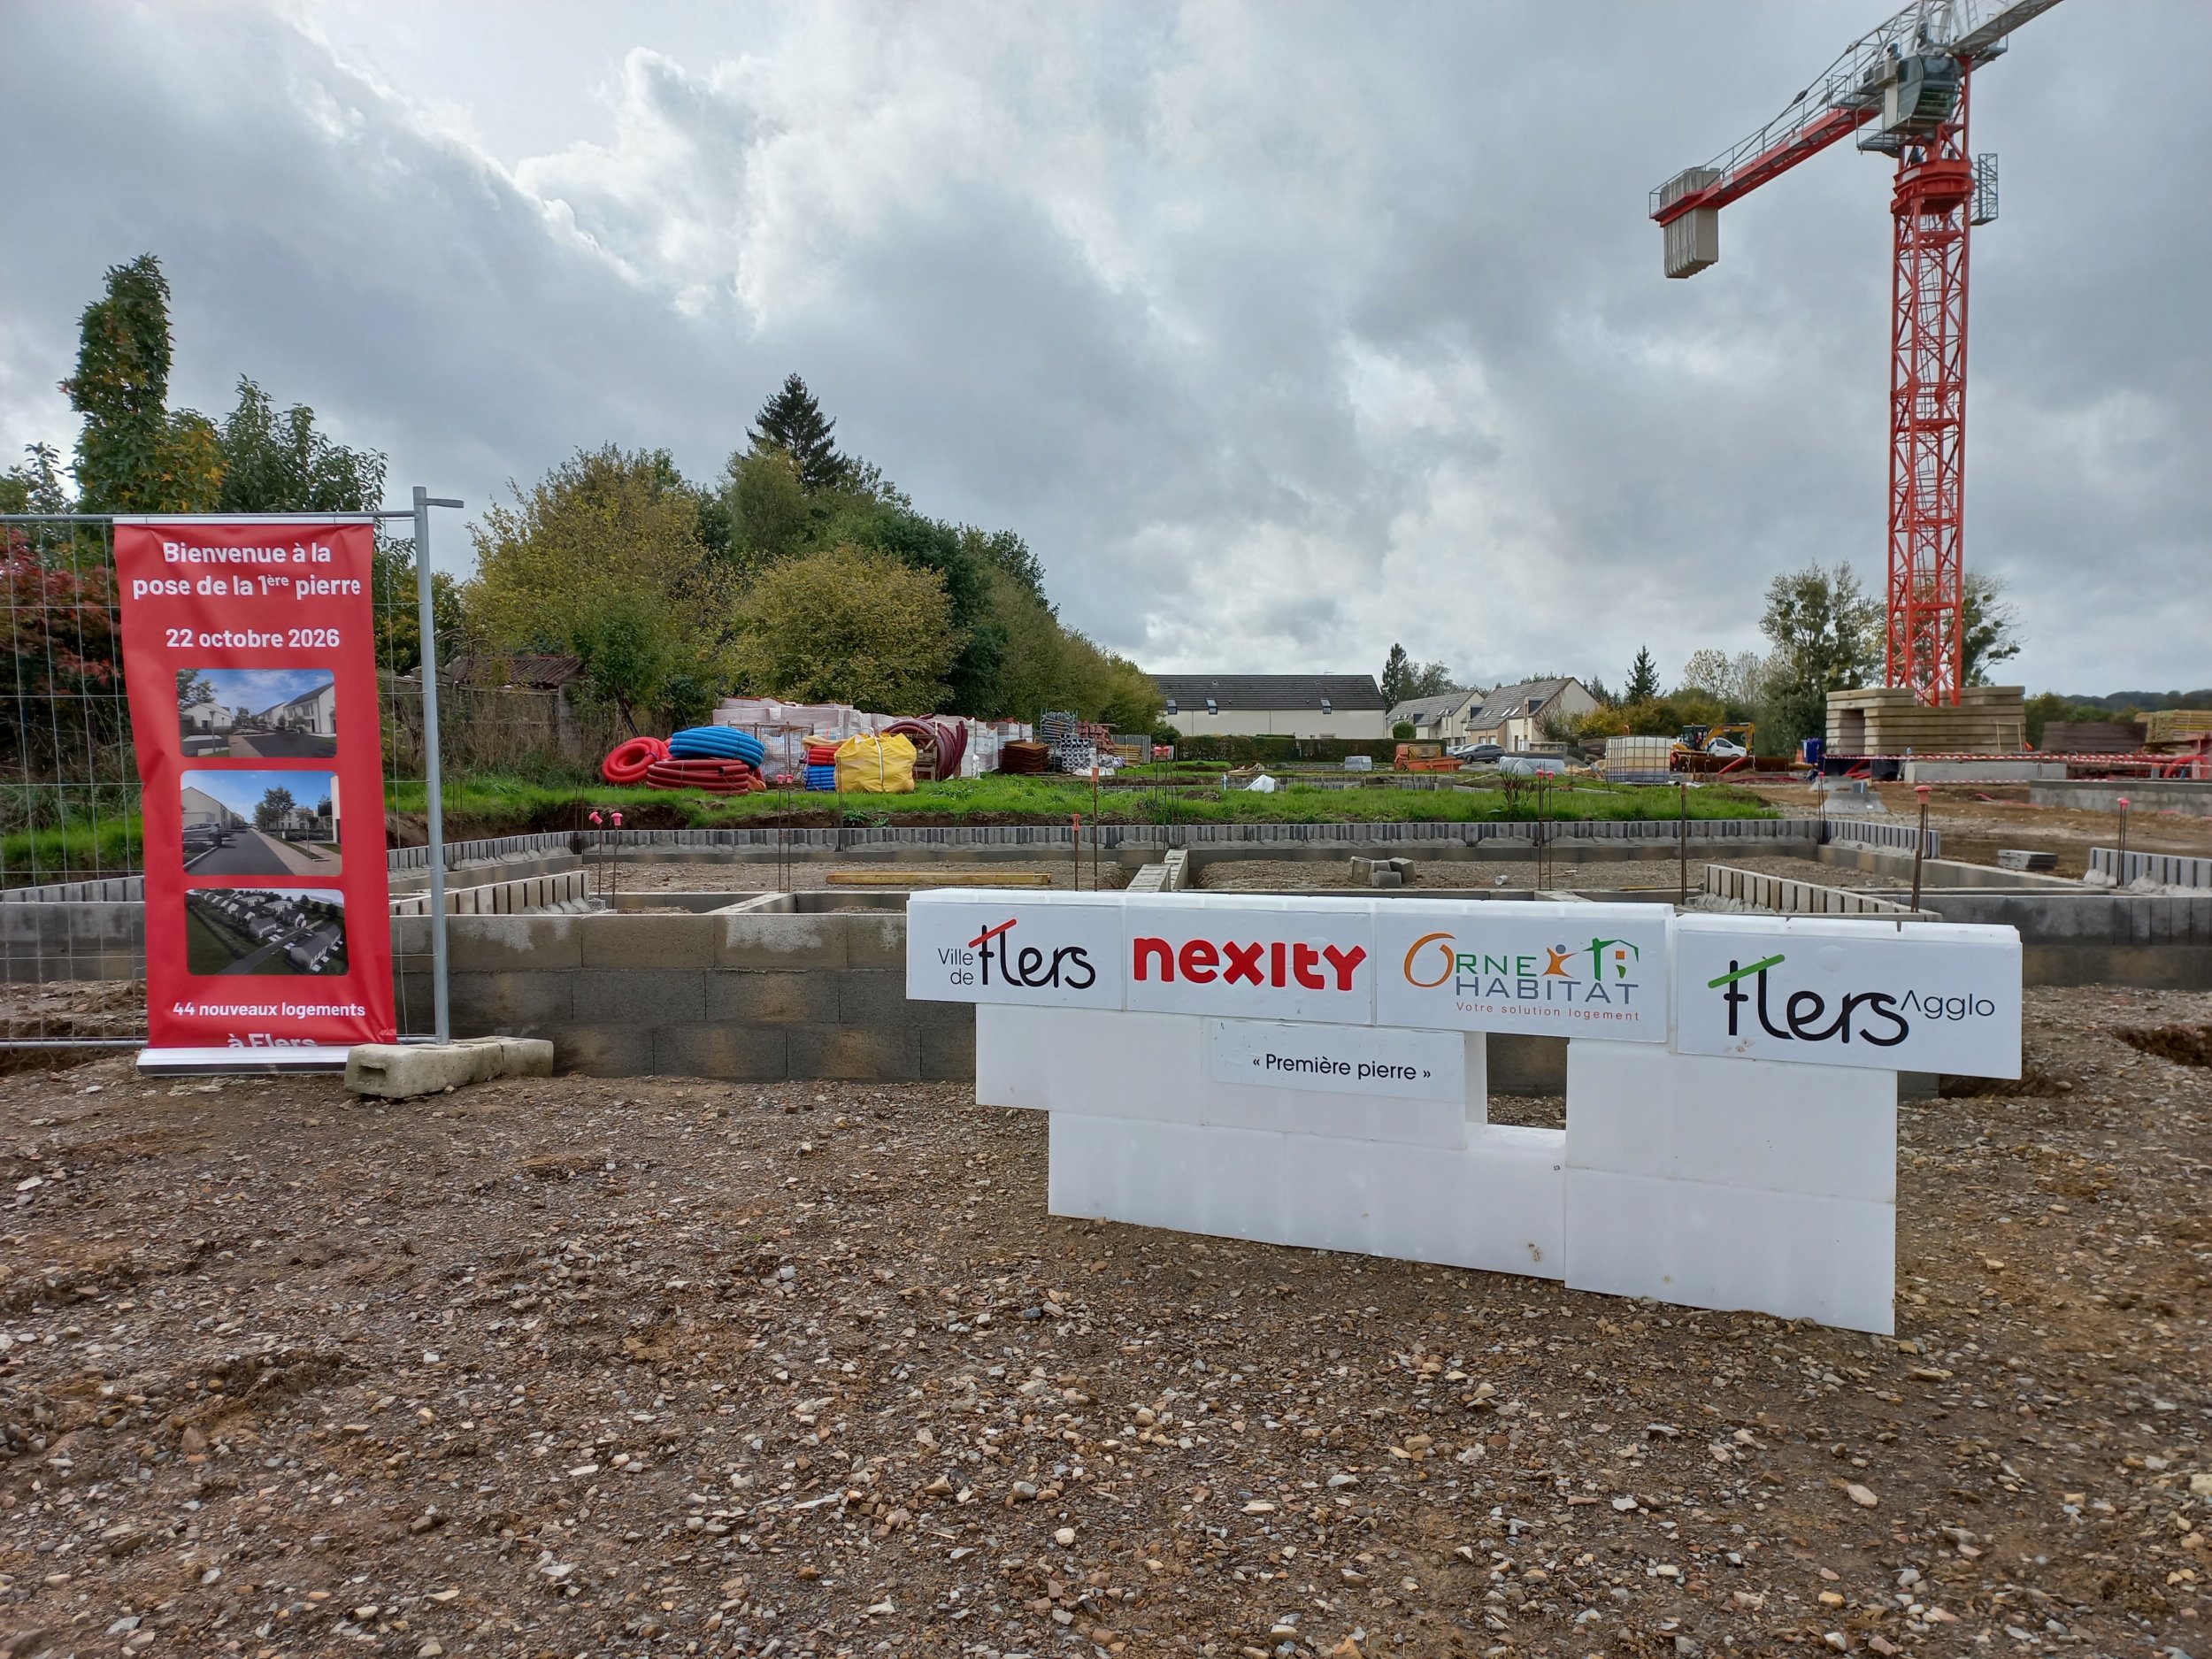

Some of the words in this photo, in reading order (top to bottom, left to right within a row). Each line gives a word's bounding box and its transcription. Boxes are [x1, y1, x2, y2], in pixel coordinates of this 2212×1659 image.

[163, 541, 287, 563] Bienvenue
[292, 542, 306, 563] à
[311, 541, 331, 563] la
[133, 579, 191, 600] pose
[196, 575, 227, 595] de
[233, 575, 253, 595] la
[257, 575, 289, 595] 1ère
[296, 575, 361, 600] pierre
[165, 628, 194, 648] 22
[198, 629, 283, 648] octobre
[288, 628, 340, 648] 2026
[938, 948, 974, 966] Ville
[1403, 933, 1537, 988] ORNE
[949, 968, 974, 986] de
[1455, 975, 1640, 1005] HABITAT
[172, 1002, 195, 1016] 44
[199, 1002, 278, 1017] nouveaux
[281, 1002, 365, 1019] logements
[1455, 1001, 1494, 1013] Votre
[1501, 1004, 1561, 1017] solution
[1569, 1007, 1640, 1021] logement
[1900, 989, 1995, 1020] Agglo
[1265, 1053, 1351, 1076] Première
[1358, 1061, 1417, 1080] pierre
